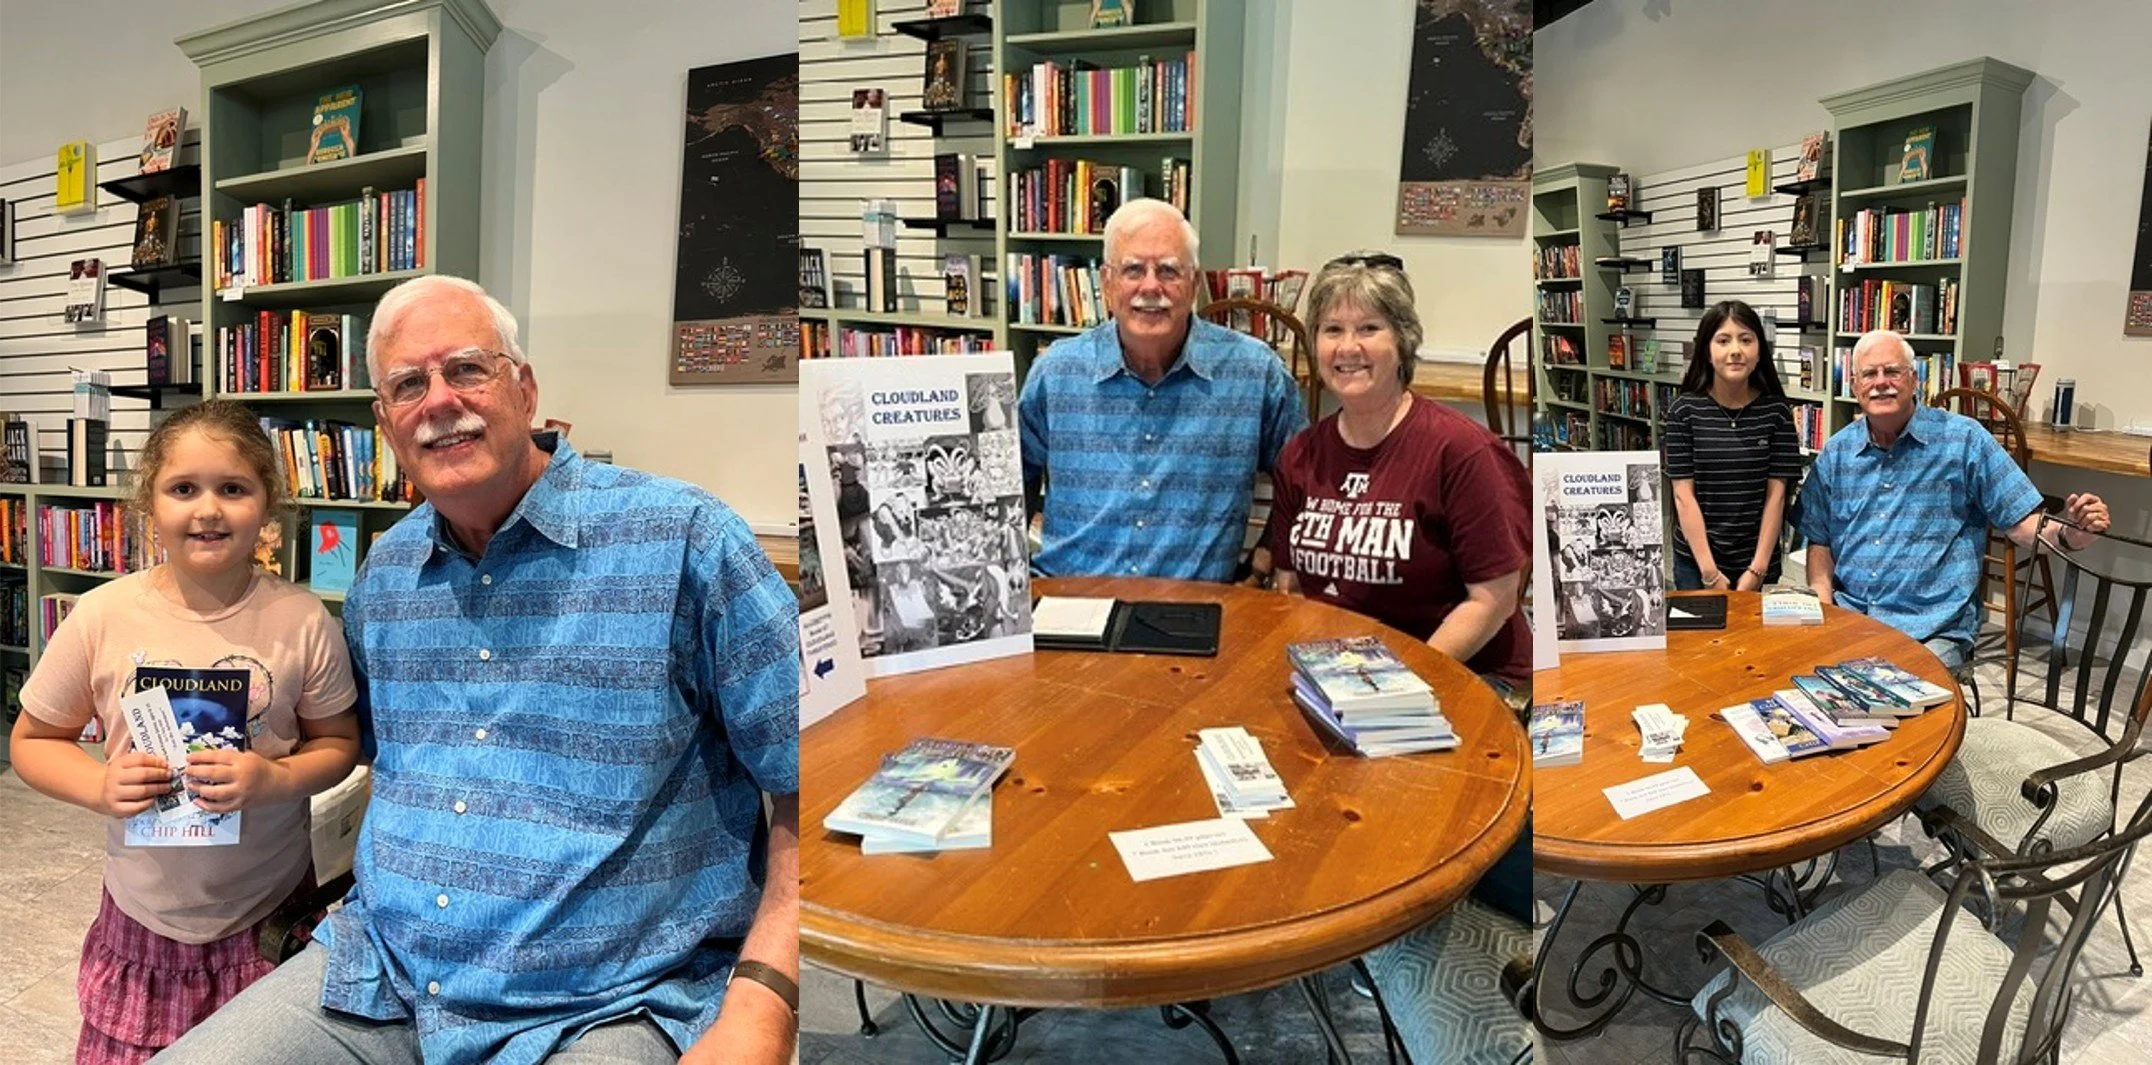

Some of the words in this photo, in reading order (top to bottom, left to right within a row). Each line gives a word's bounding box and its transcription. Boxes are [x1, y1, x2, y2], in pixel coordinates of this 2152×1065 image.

[872, 389, 959, 406] CLOUDLAND
[872, 407, 961, 425] CREATURES
[1563, 474, 1622, 484] CLOUDLAND
[1563, 485, 1622, 496] CREATURES
[1319, 498, 1353, 515] HOME
[1376, 501, 1402, 518] THE
[1334, 516, 1414, 560] MAN
[1295, 547, 1404, 584] FOOTBALL
[140, 676, 243, 693] CLOUDLAND
[141, 825, 177, 838] CHIP
